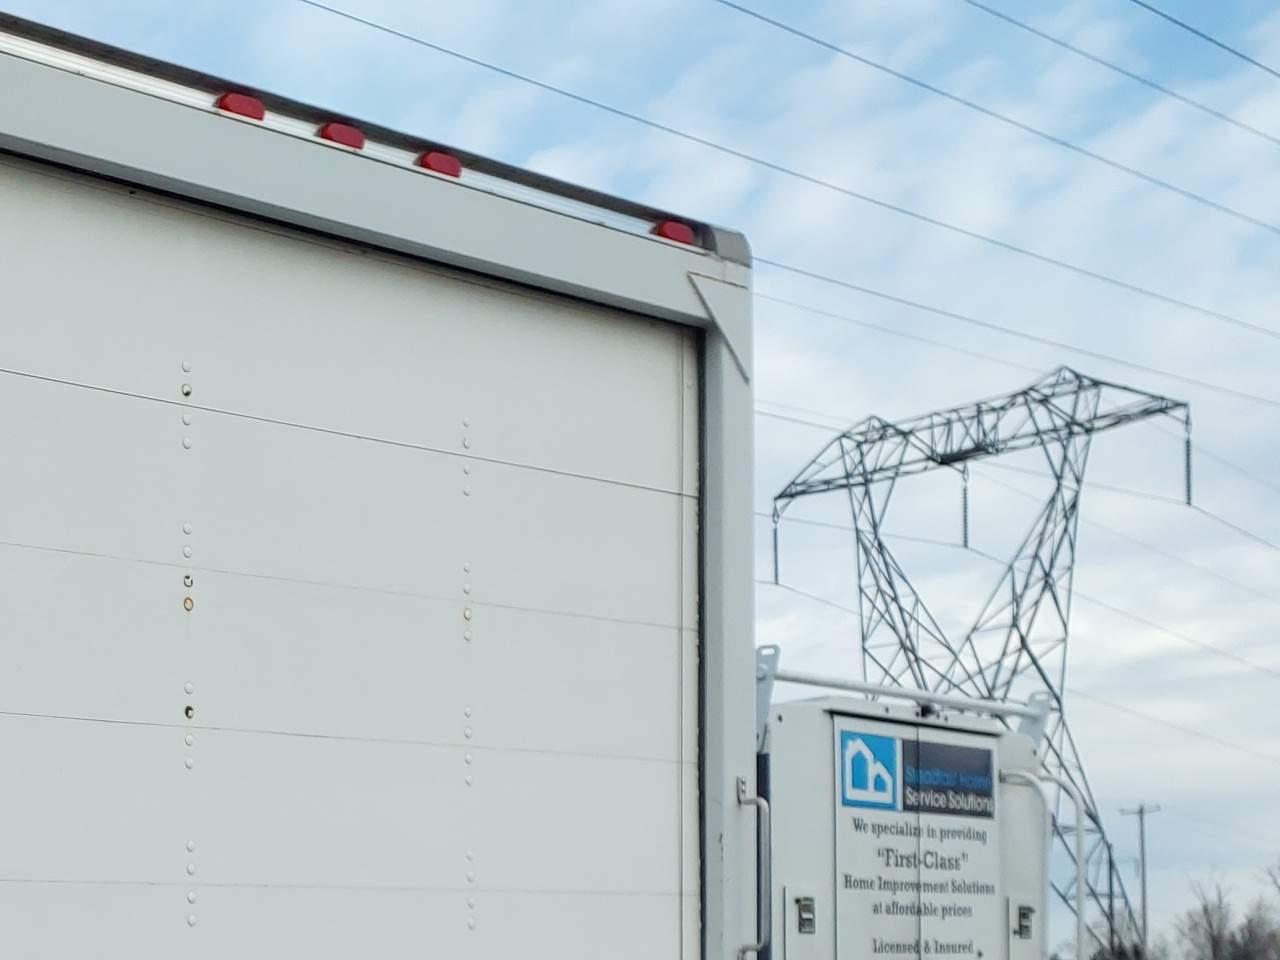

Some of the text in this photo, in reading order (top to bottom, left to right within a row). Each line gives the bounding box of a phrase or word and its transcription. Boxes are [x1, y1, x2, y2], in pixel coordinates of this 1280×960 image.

[905, 786, 948, 809] Service
[852, 816, 869, 834] We
[926, 824, 937, 839] in
[940, 826, 988, 845] providing
[844, 874, 996, 895] Home Improvement Solutions
[873, 901, 973, 919] at affordable prices
[873, 938, 920, 954] Licensed
[935, 941, 973, 954] Insured
